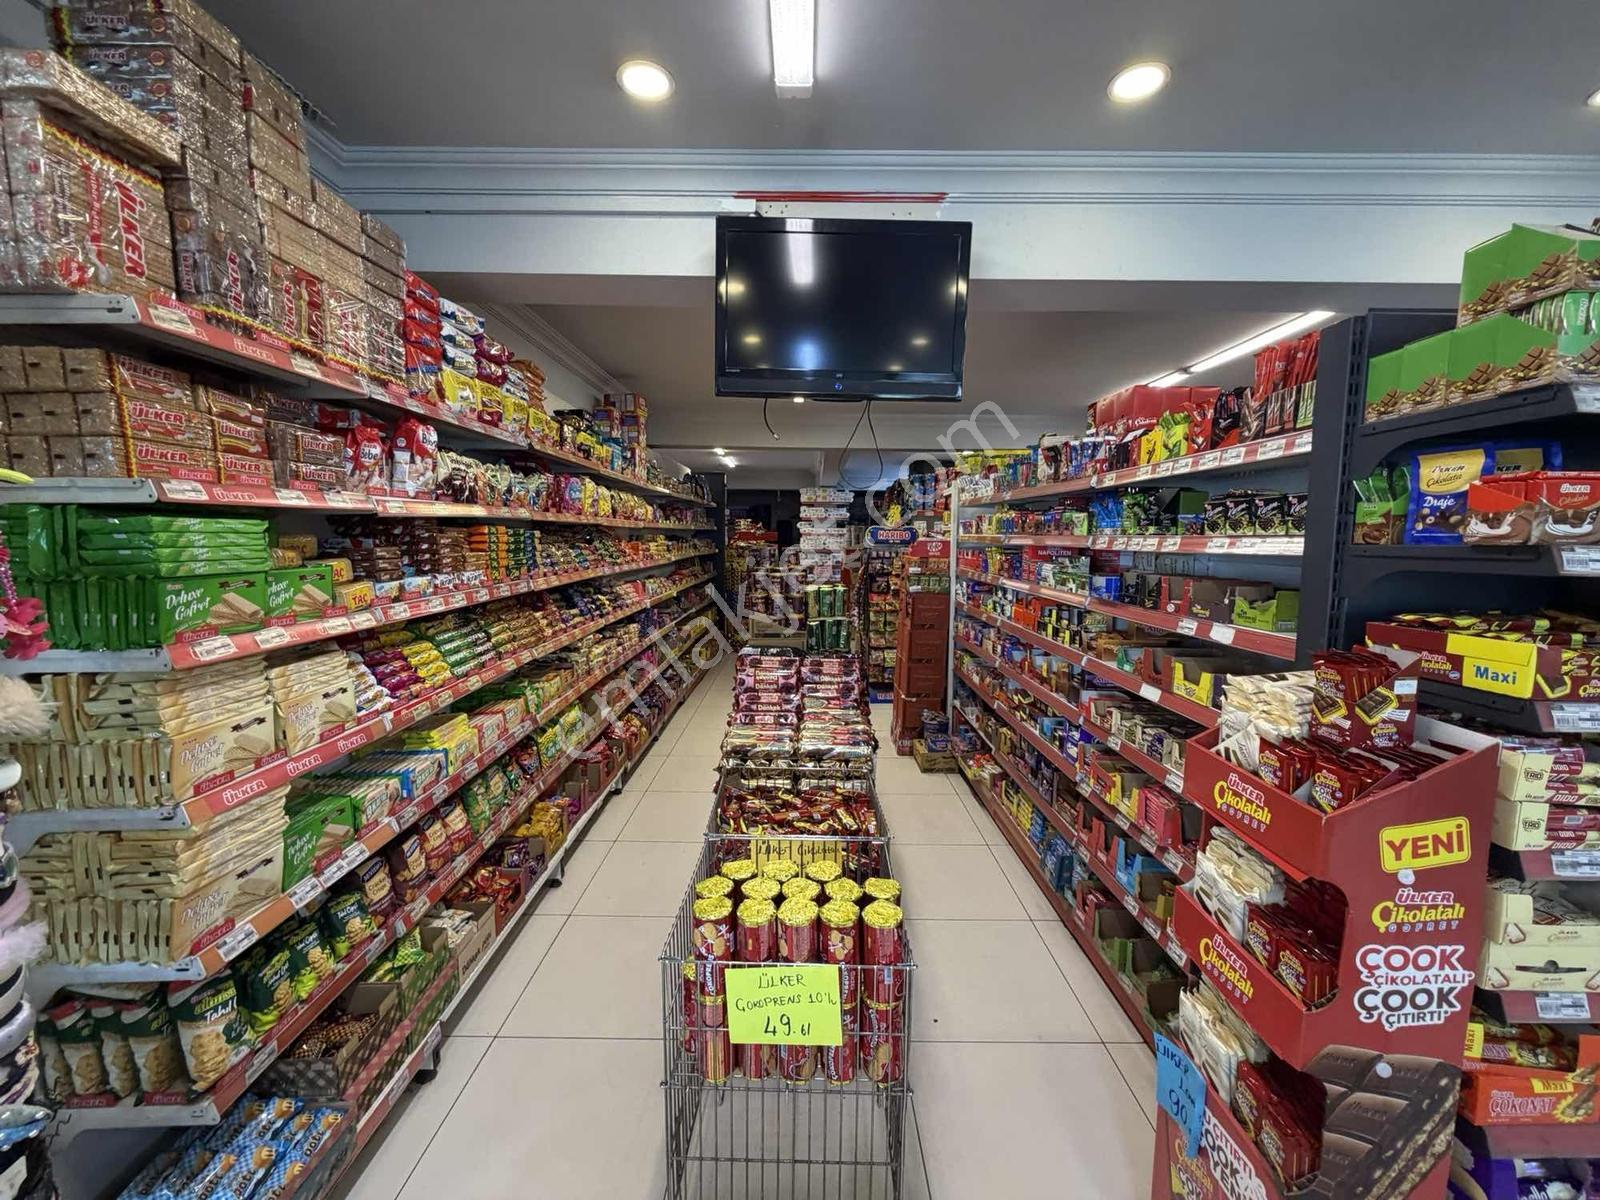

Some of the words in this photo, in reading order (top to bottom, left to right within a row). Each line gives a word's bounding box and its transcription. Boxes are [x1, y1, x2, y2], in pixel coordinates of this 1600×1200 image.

[113, 180, 147, 280] ÜLKER
[119, 357, 175, 383] ÜLKER
[131, 401, 186, 425] ÜLKER
[220, 420, 255, 441] ÜLKER
[137, 443, 190, 465] ÜLKER
[303, 436, 335, 453] ÜLKER
[224, 457, 262, 474] ÜLKER
[304, 464, 337, 482] ÜLKER
[214, 486, 257, 501] ÜLKER
[1423, 495, 1457, 509] Draje
[878, 530, 911, 540] HARIBO
[165, 587, 205, 610] Deluxe
[175, 597, 211, 621] Gofret
[1474, 665, 1518, 685] Maxi
[337, 734, 367, 753] ÜLKER
[287, 754, 323, 777] ÜLKER
[222, 779, 268, 806] ÜLKER
[1228, 773, 1265, 807] ÜLKER
[1213, 780, 1272, 825] Çikolatalı
[1385, 823, 1465, 862] YENİ
[1396, 887, 1455, 905] ÜLKER
[1371, 900, 1466, 934] Çikolatalı
[1388, 921, 1460, 933] GOFRET
[1213, 933, 1248, 979] ÜLKER
[1356, 945, 1465, 978] ÇOOK
[1200, 938, 1254, 999] Çikolatalı
[758, 972, 807, 989] ÜLKER
[205, 999, 233, 1024] Tahıl
[1354, 984, 1461, 1020] ÇOOK
[1465, 1029, 1476, 1052] Maxi
